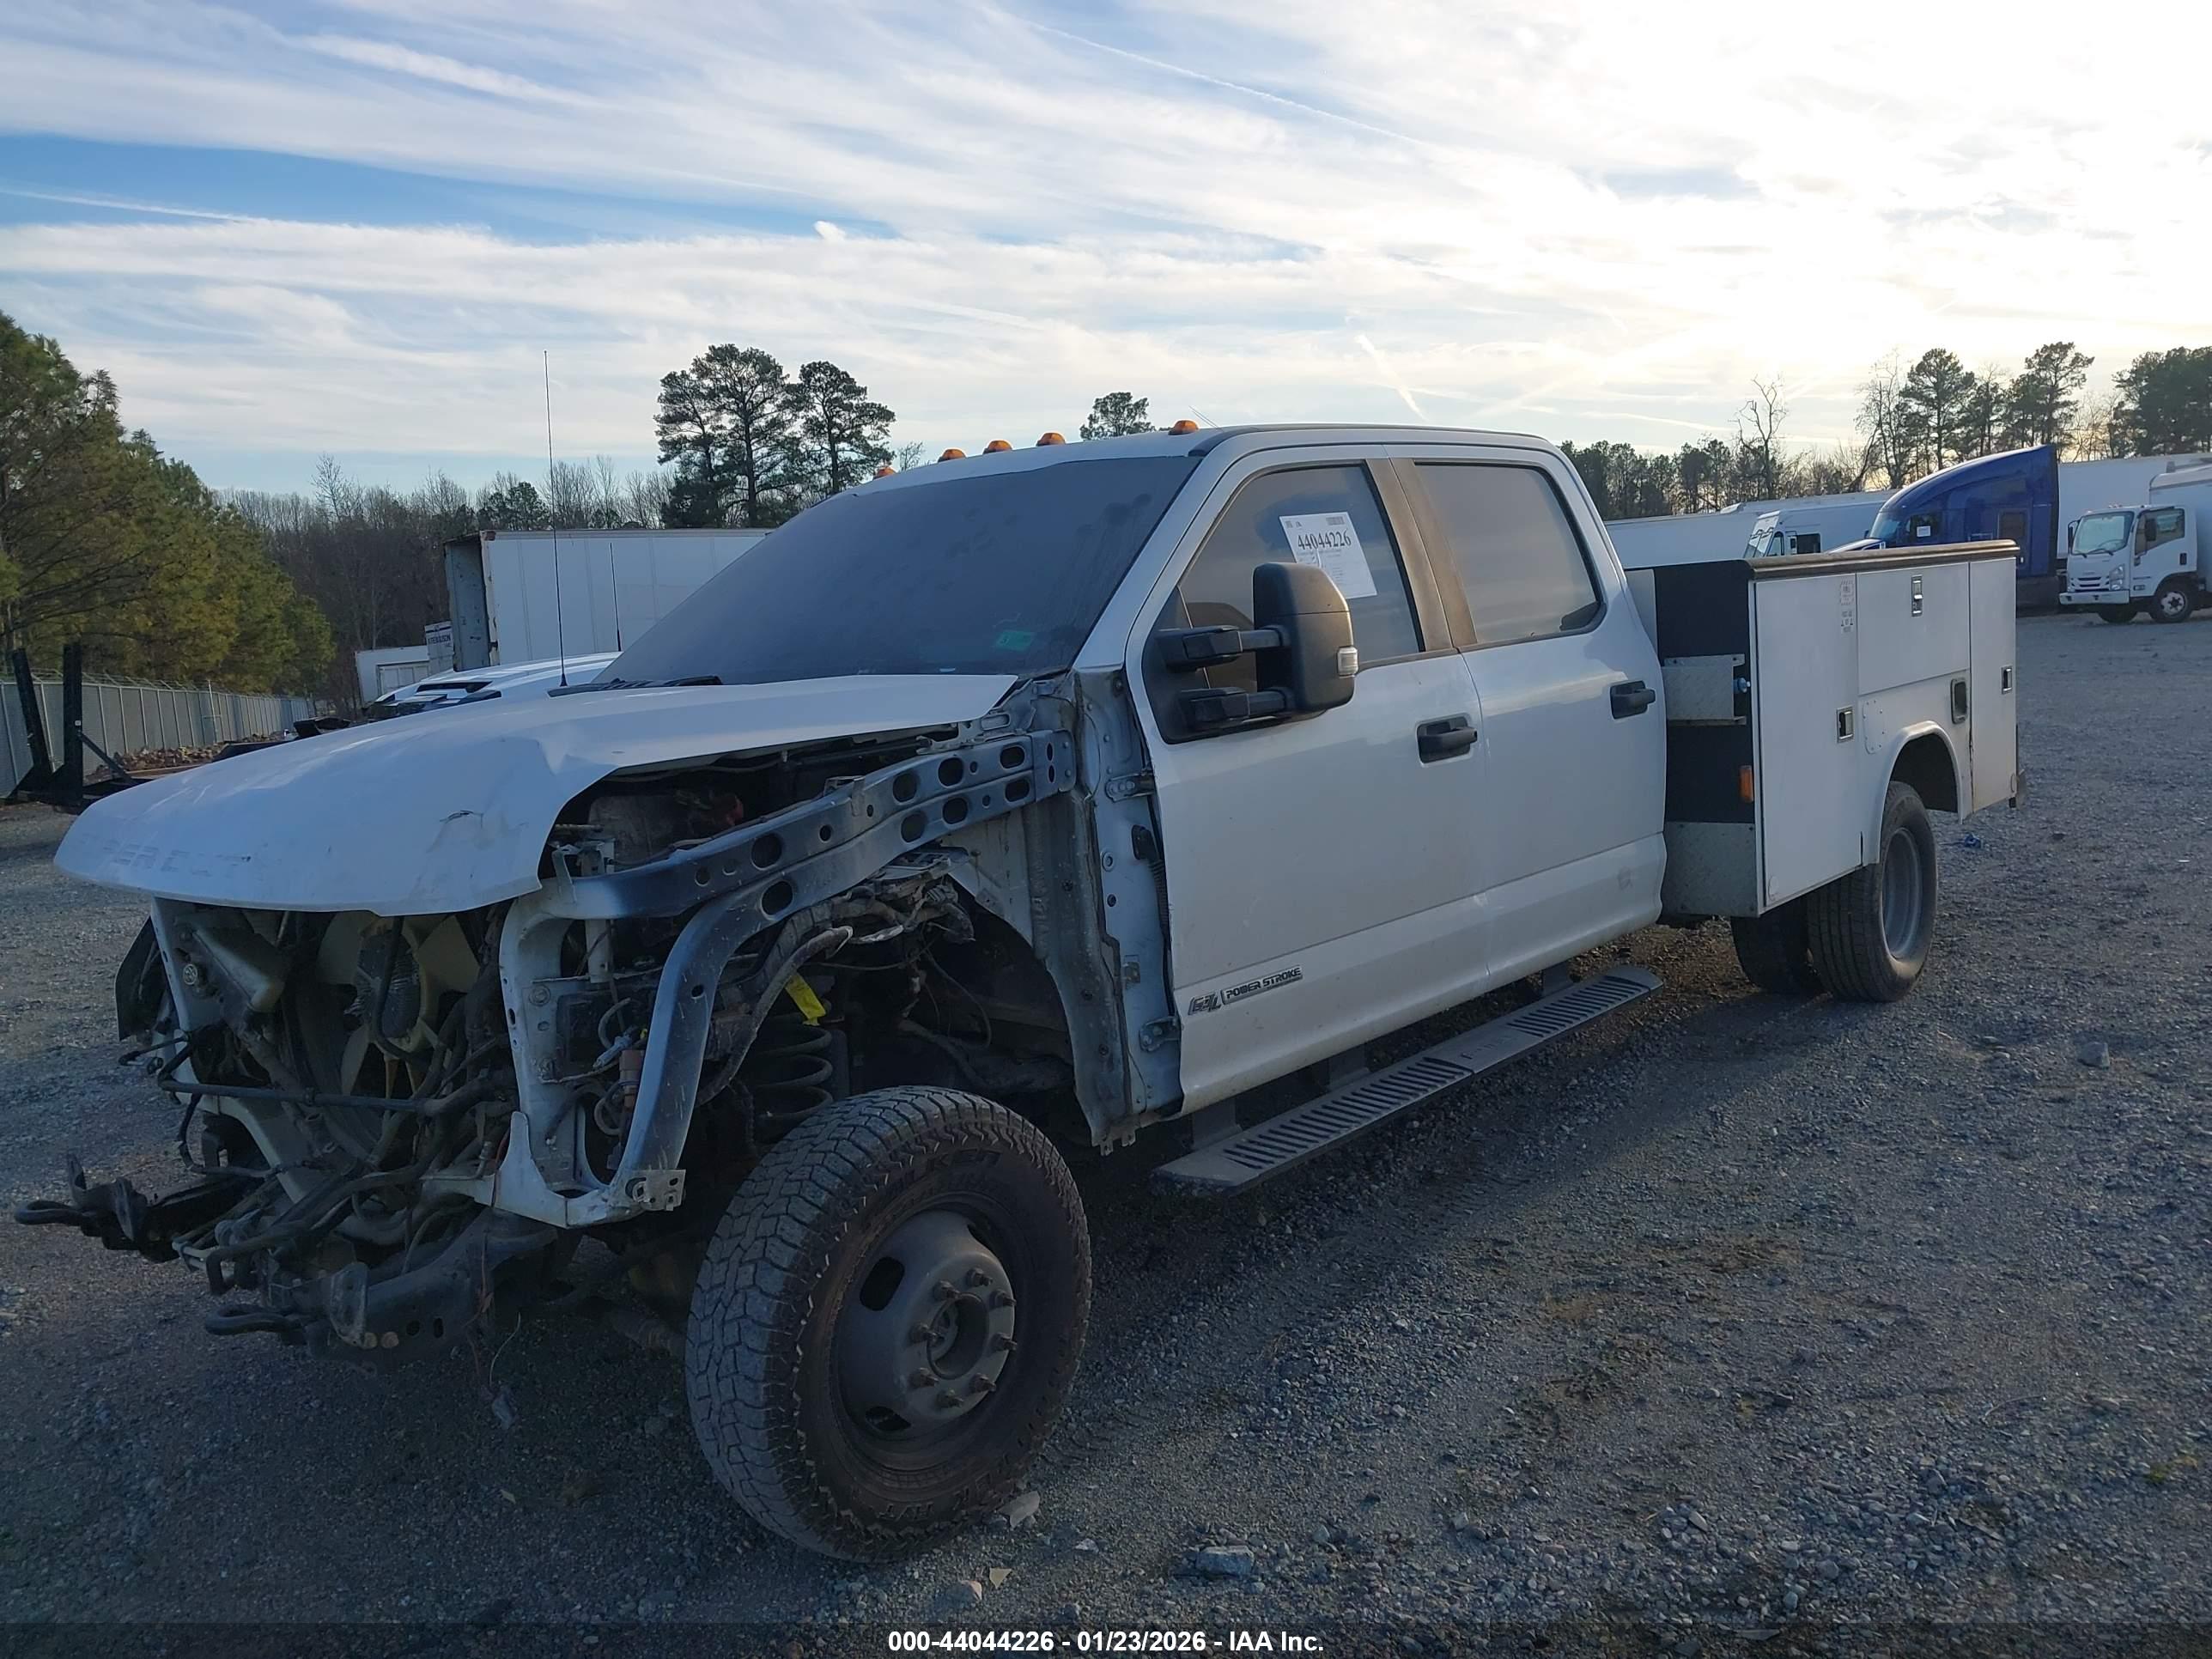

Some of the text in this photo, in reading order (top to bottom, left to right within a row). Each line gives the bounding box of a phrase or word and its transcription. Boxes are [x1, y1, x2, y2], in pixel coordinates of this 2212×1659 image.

[1297, 531, 1352, 550] 44044226
[1225, 981, 1261, 1000] POWER
[1262, 967, 1302, 988] STROKE
